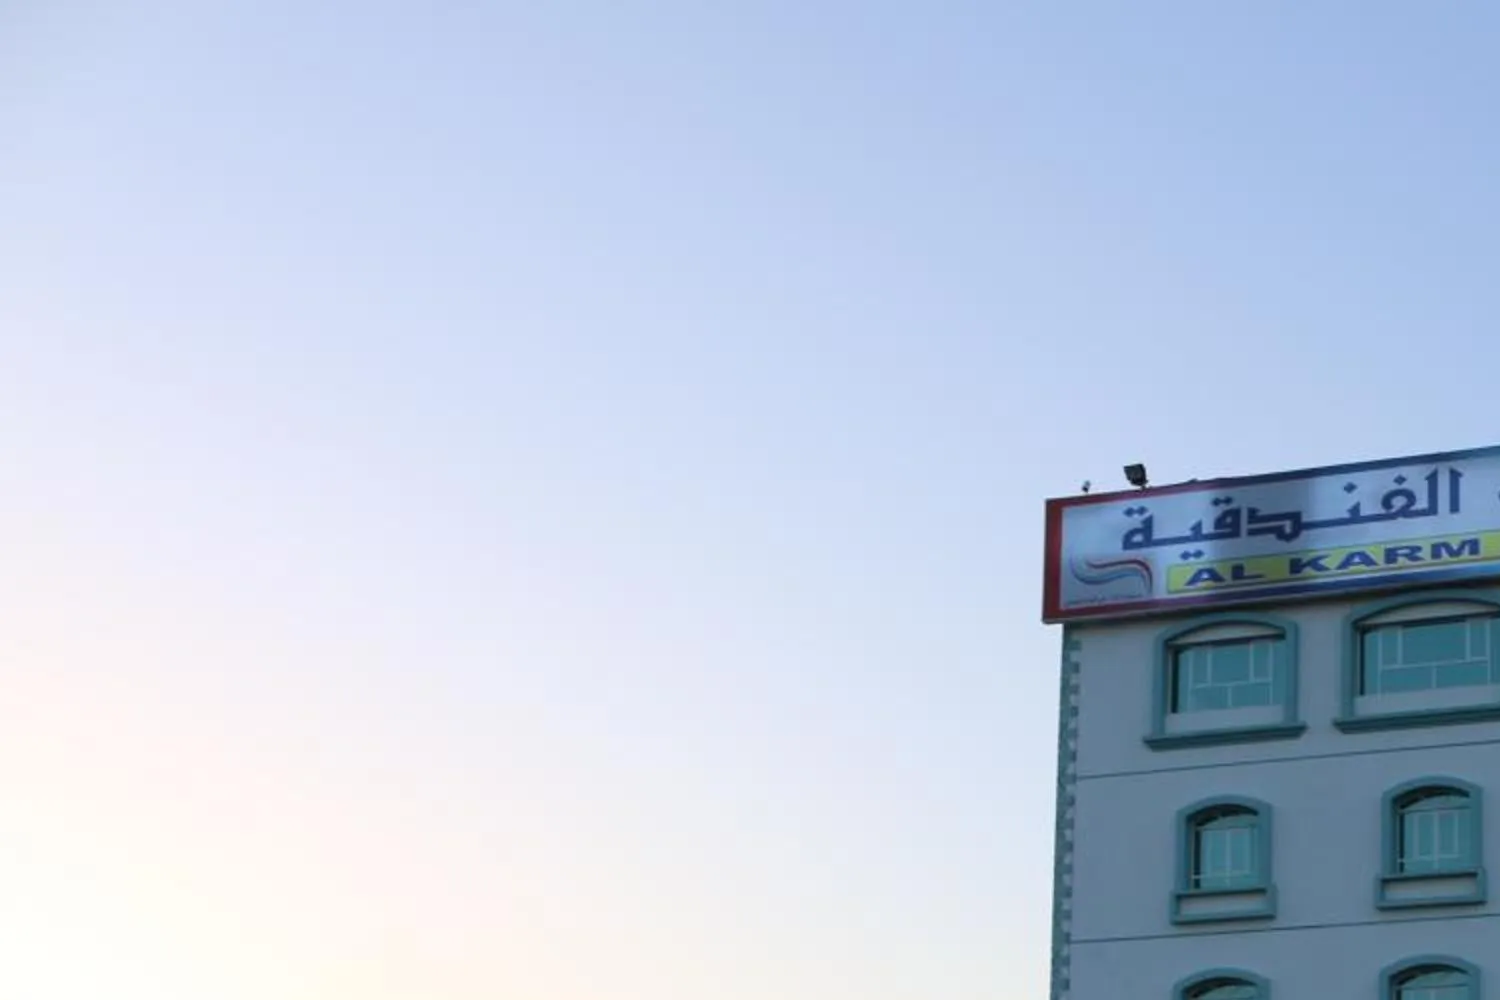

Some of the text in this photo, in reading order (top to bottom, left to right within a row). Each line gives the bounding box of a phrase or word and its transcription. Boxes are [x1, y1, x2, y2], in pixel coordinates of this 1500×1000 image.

[1122, 466, 1463, 561] الفندقية
[1184, 563, 1266, 587] AL
[1289, 538, 1481, 574] KARM
